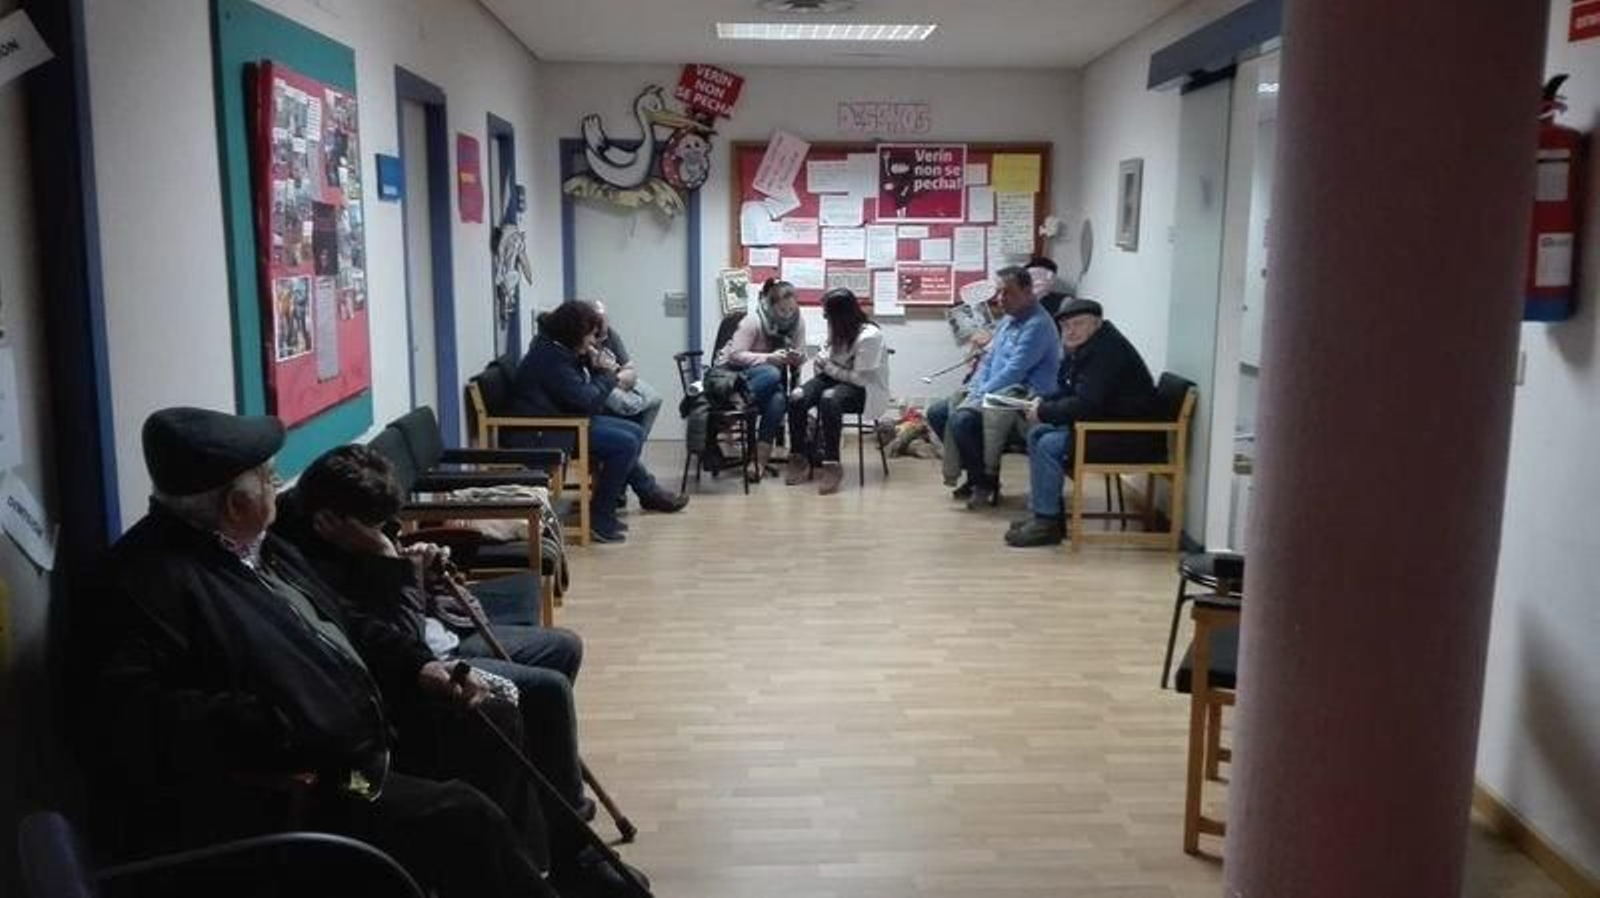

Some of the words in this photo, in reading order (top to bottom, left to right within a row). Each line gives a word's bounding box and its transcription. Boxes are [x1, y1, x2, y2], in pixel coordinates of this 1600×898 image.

[694, 79, 727, 100] NON
[675, 86, 693, 101] SE
[692, 92, 735, 116] PECHA
[914, 165, 942, 177] non
[944, 165, 961, 177] se
